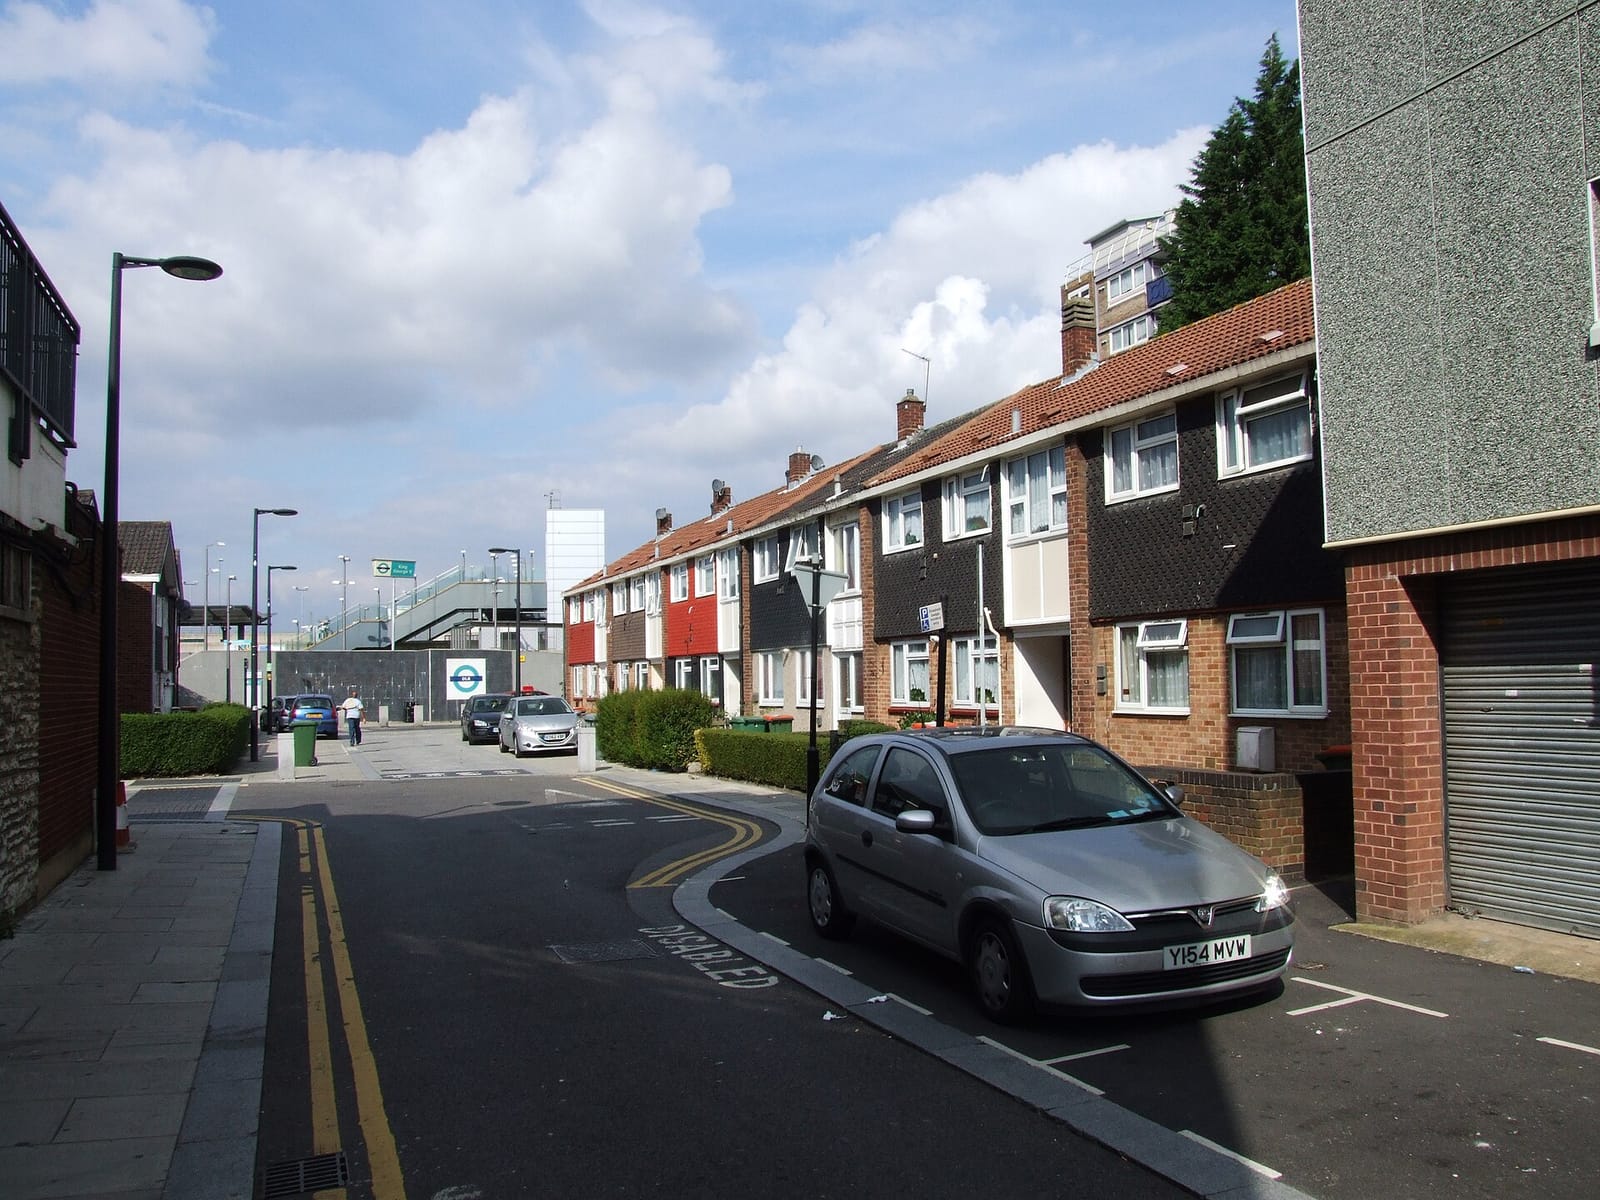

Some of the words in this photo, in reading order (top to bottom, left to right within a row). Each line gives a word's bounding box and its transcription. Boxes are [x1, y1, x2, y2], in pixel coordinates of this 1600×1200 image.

[922, 608, 928, 618] P
[637, 924, 779, 989] DISABLED
[1169, 944, 1210, 966] Y154
[1214, 938, 1246, 960] MVW
